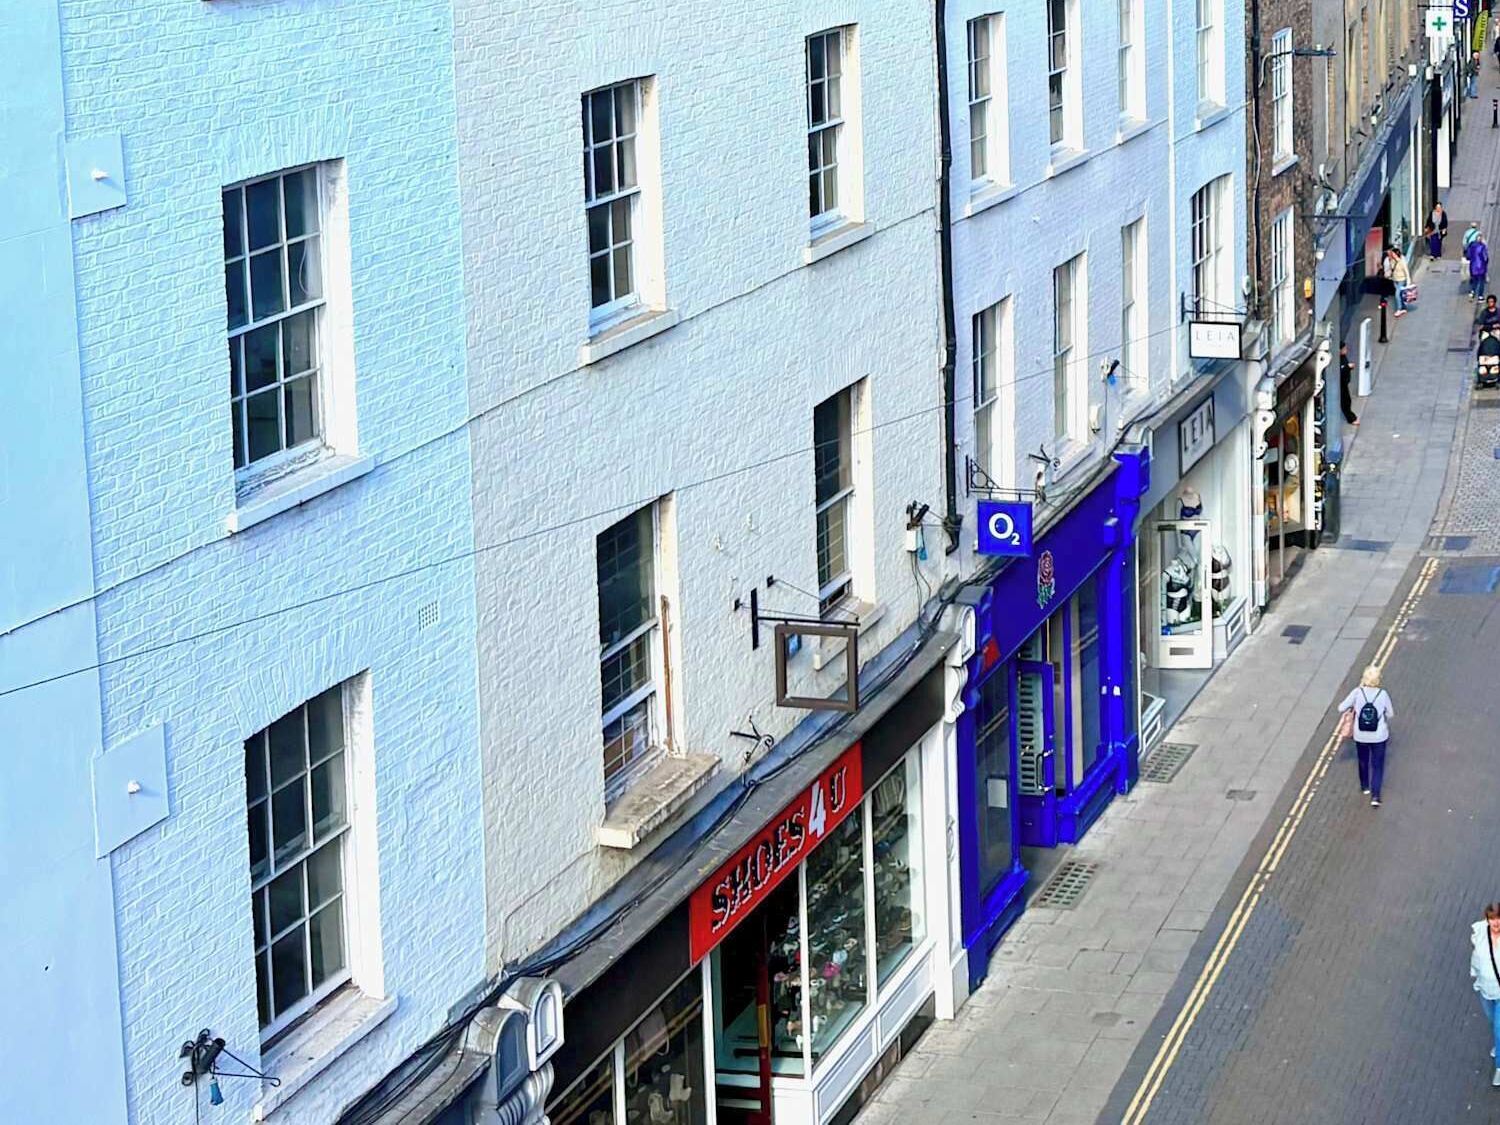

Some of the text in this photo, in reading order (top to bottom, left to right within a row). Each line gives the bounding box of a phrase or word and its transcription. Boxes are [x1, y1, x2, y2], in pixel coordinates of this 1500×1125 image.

[1195, 330, 1235, 341] LEIA
[988, 512, 1021, 546] O2
[711, 765, 847, 934] SHOES 4 U
